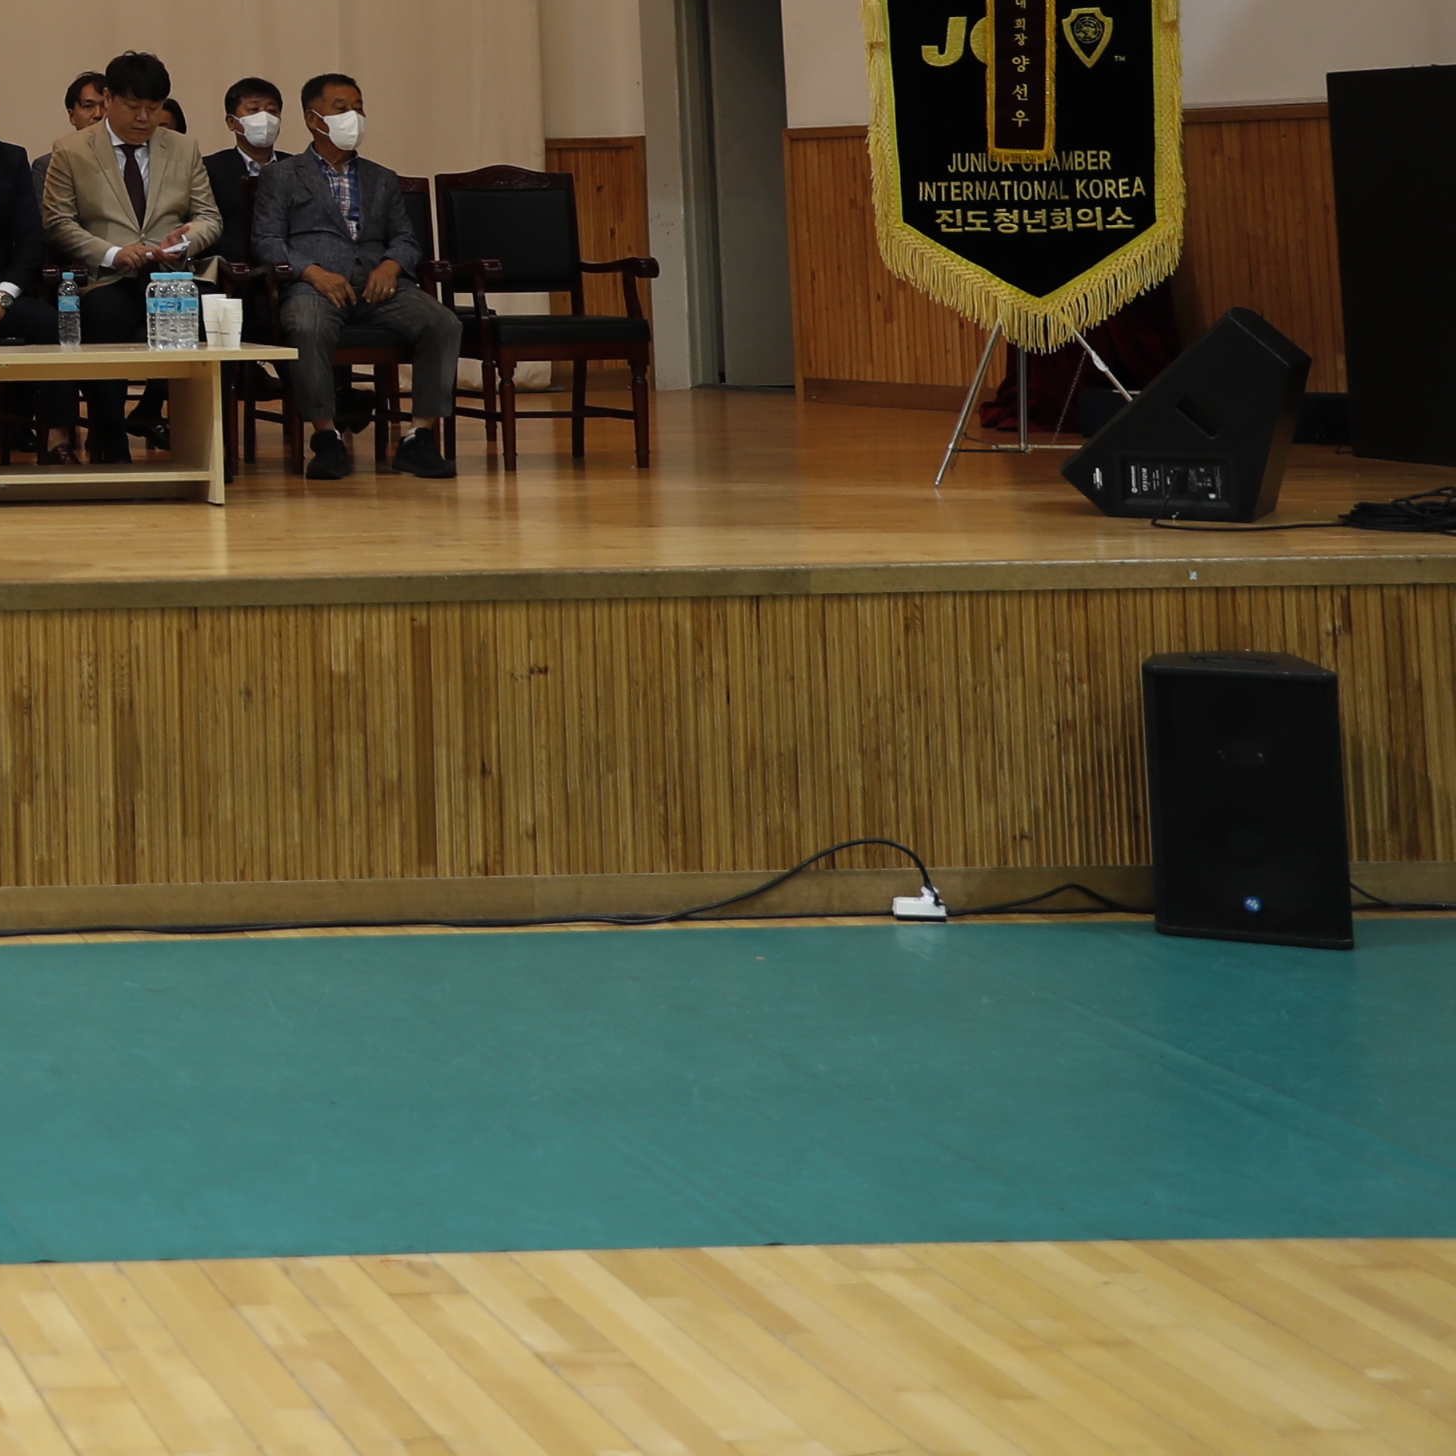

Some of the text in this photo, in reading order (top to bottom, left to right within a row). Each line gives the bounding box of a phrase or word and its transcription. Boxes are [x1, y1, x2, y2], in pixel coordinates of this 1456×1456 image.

[918, 176, 1147, 202] INTERNATIONAL KOREA
[935, 206, 1135, 234] 진도청년회의소
